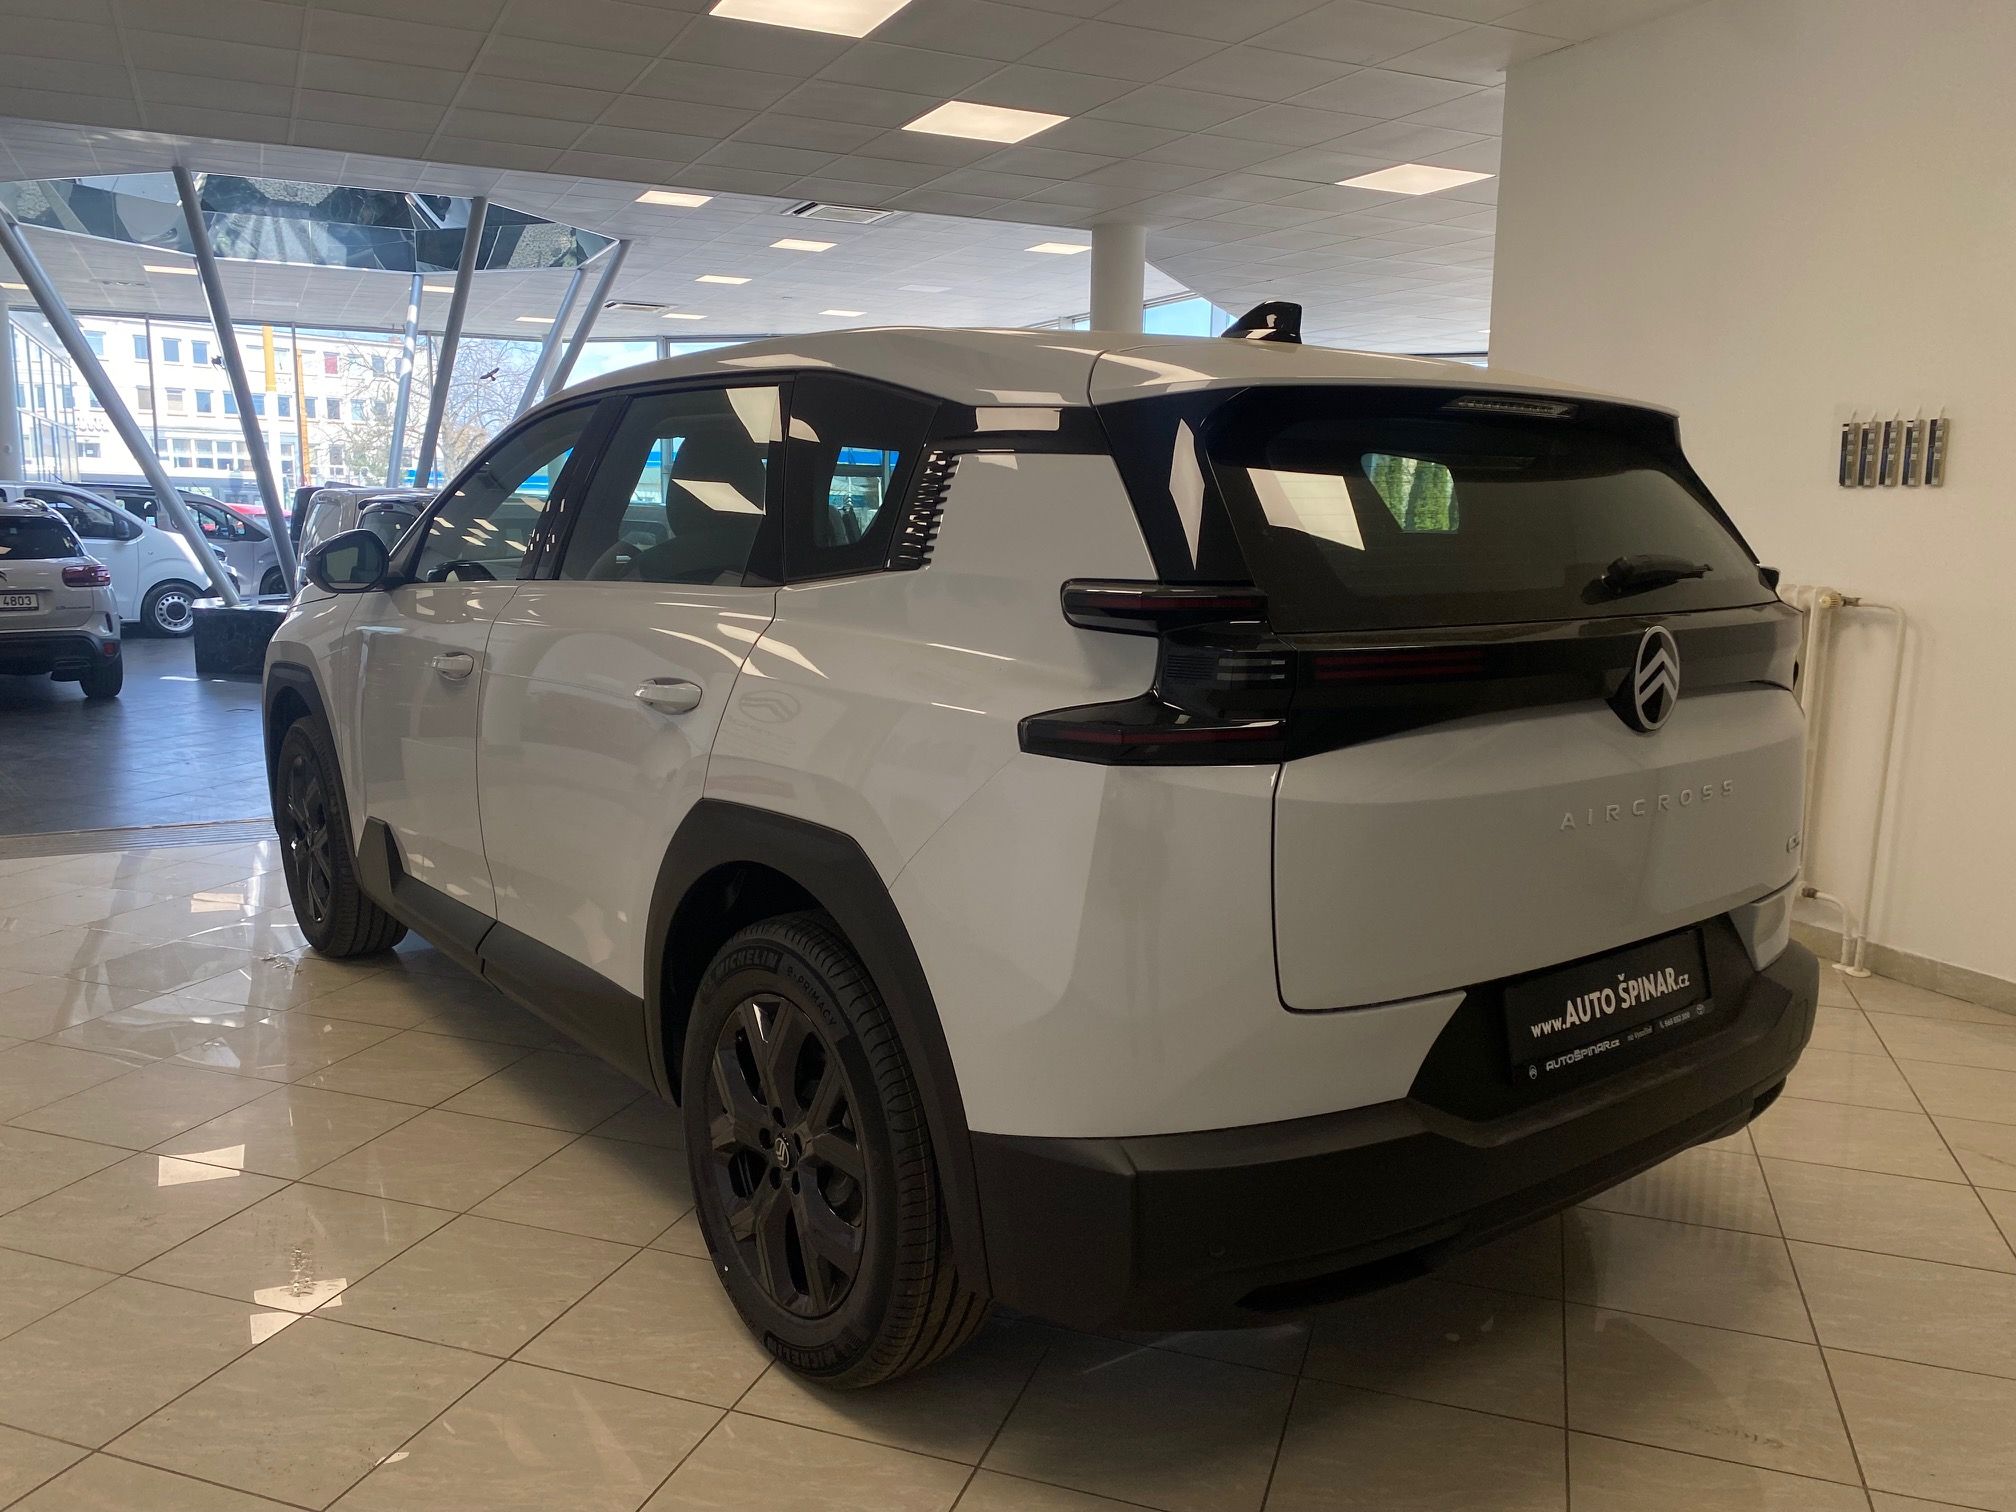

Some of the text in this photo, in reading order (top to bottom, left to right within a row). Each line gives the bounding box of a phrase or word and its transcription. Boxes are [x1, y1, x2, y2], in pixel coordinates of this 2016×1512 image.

[3, 596, 32, 606] 4803
[1560, 780, 1734, 831] AIRCROSS
[1531, 968, 1690, 1038] www.AUTO ŠPINAR.cz
